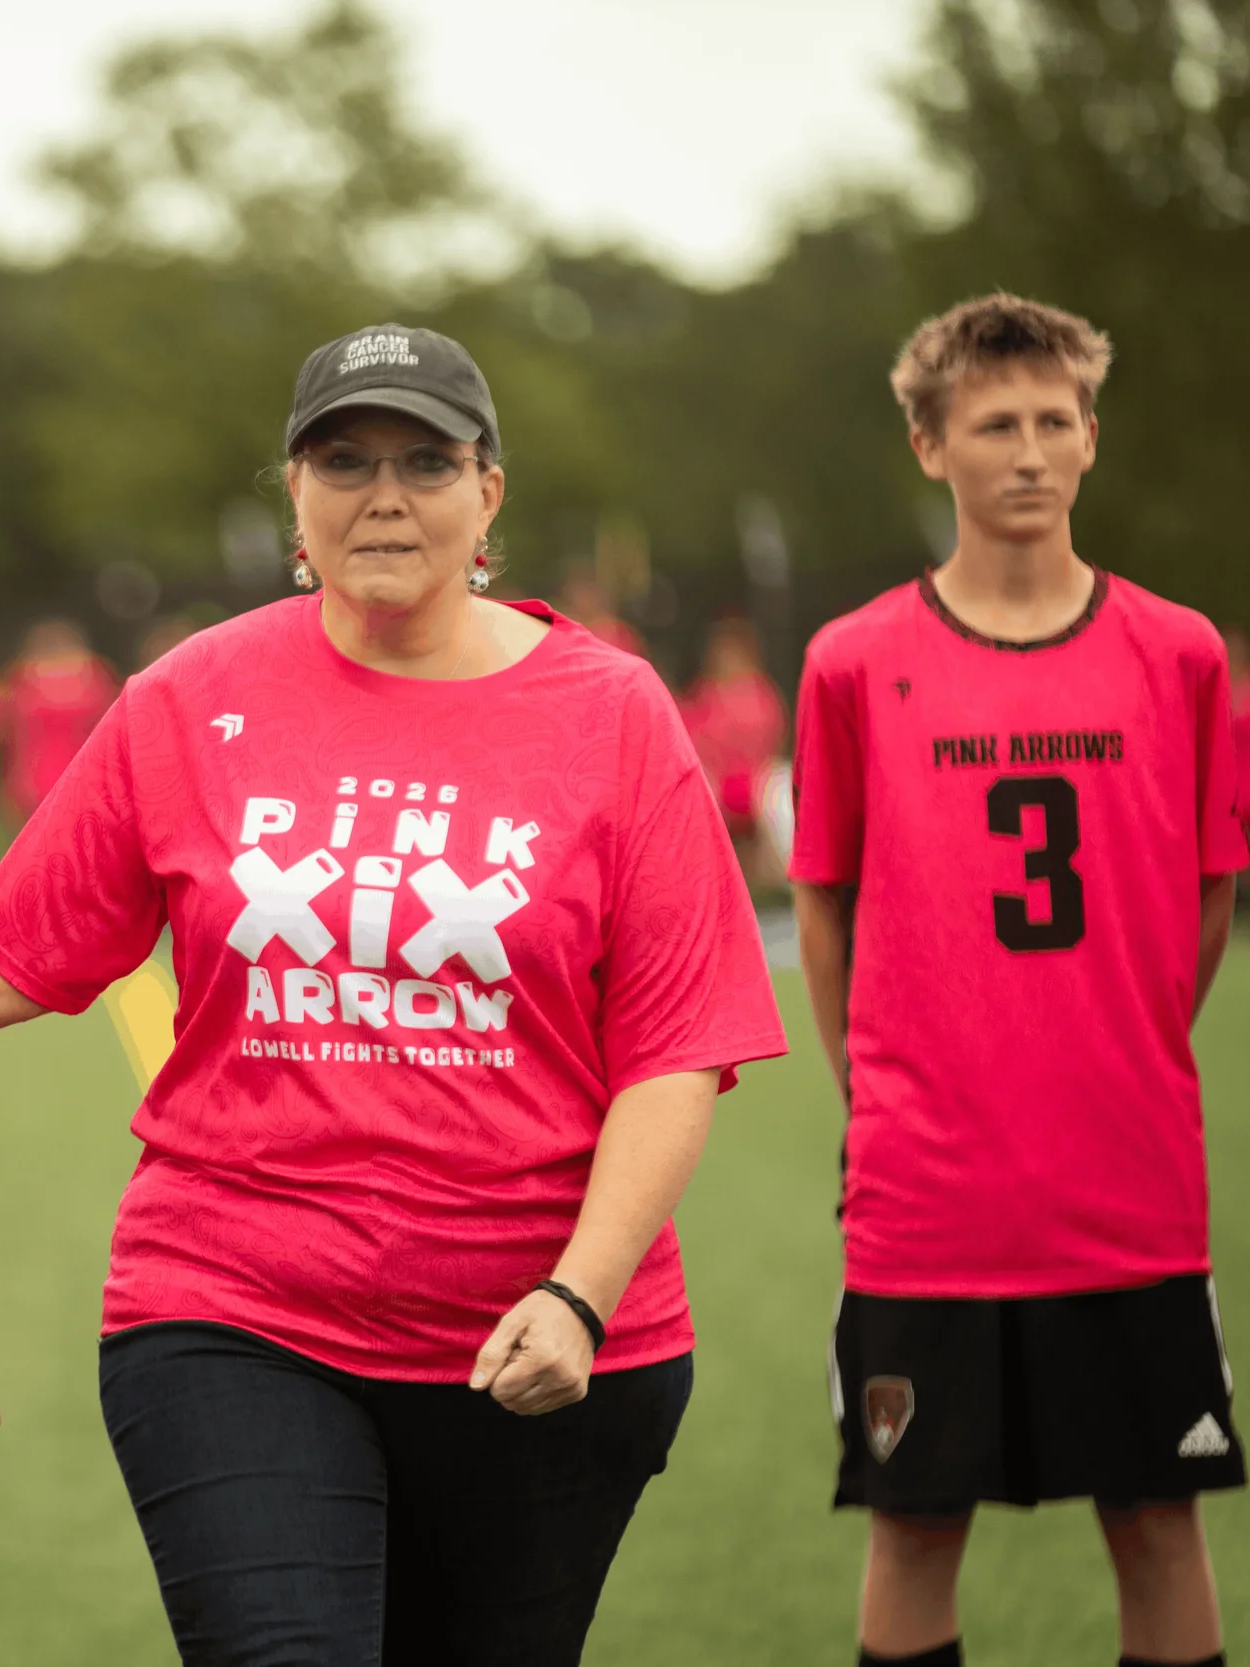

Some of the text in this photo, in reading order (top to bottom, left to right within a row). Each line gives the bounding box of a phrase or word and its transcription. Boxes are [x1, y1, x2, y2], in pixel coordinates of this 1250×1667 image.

[347, 342, 410, 360] CANCER
[349, 334, 410, 350] BRAIN
[339, 352, 420, 374] SURVIVOR
[932, 731, 1123, 768] PINK ARROWS
[336, 776, 459, 804] 2026
[987, 774, 1086, 953] 3
[246, 965, 515, 1032] ARROW
[241, 1037, 314, 1061] LOWELL
[405, 1046, 515, 1068] TOGETHER
